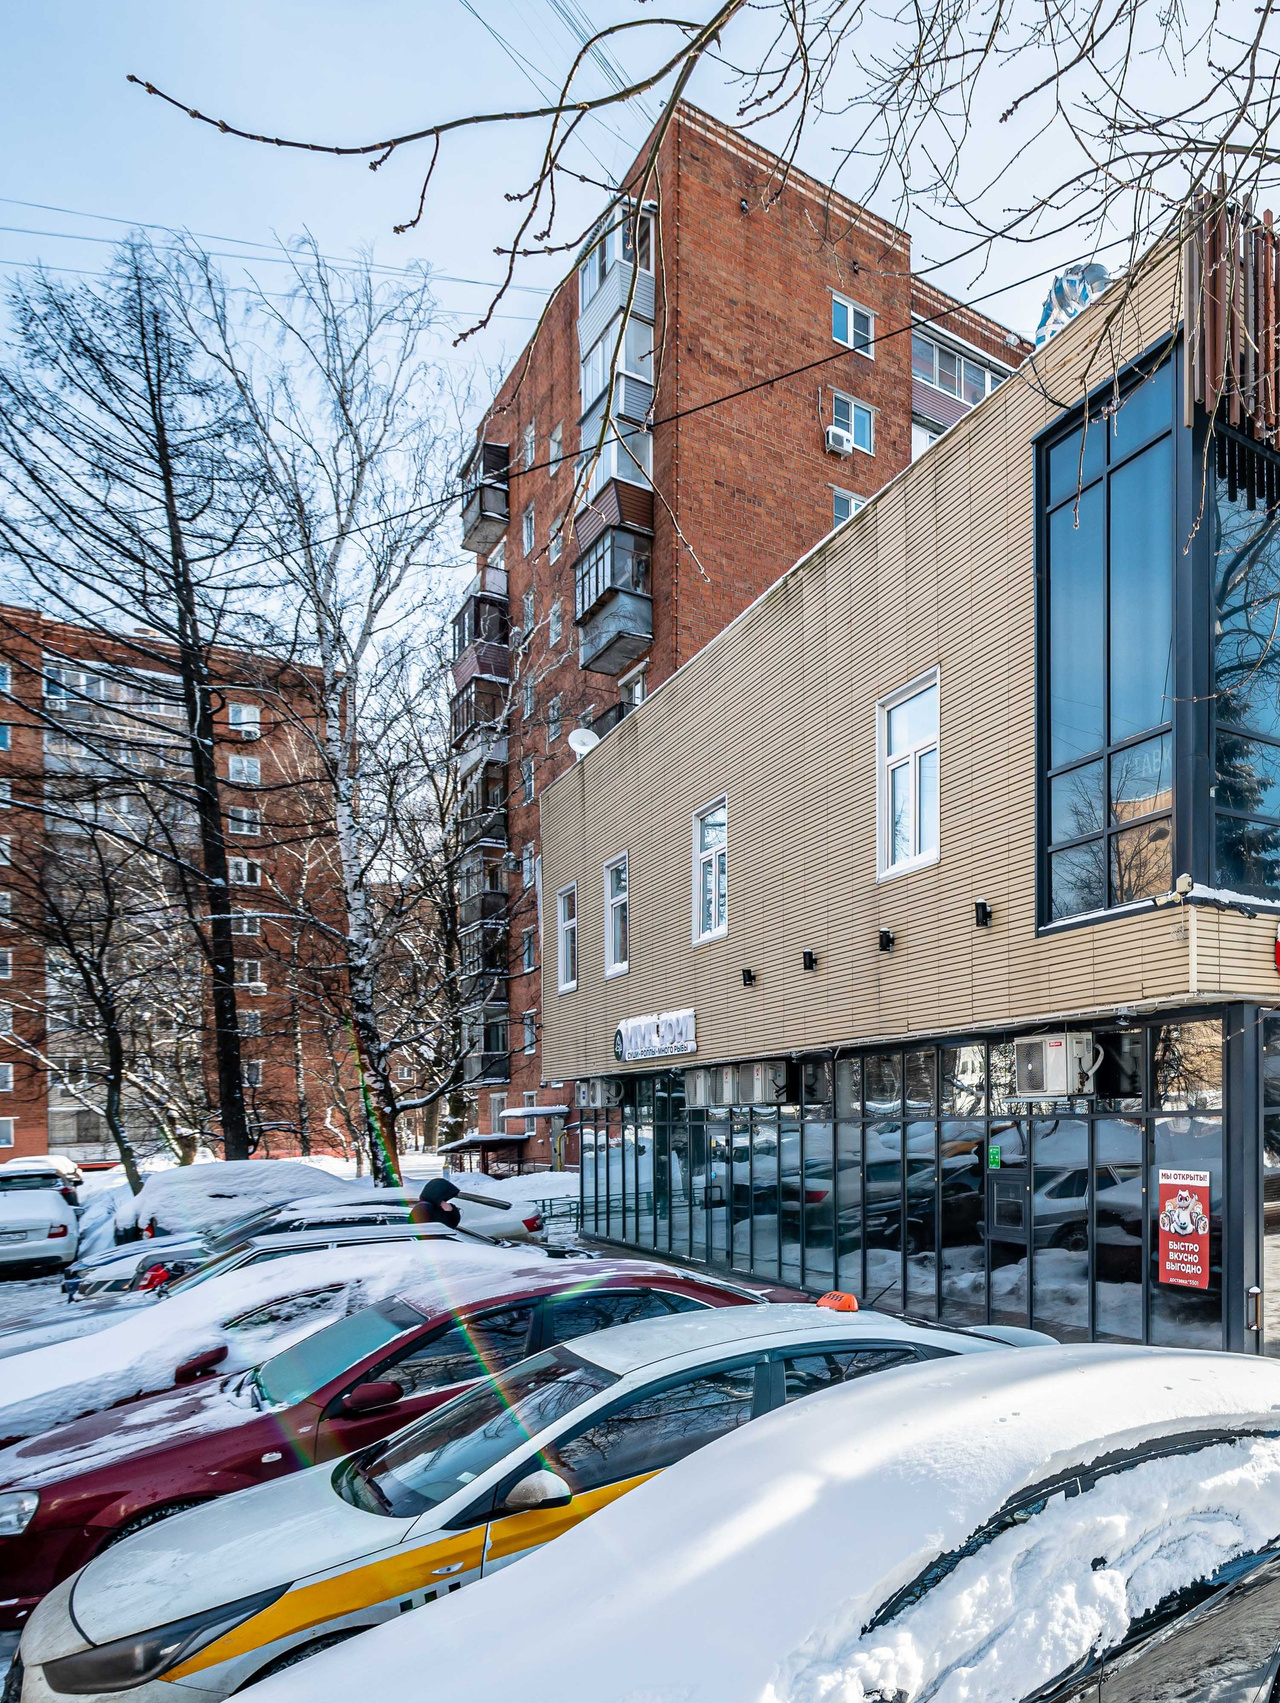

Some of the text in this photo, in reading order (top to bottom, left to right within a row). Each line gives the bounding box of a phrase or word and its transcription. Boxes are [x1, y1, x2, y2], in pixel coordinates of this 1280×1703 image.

[674, 1044, 689, 1053] РЫБЫ
[1161, 1172, 1172, 1180] МЫ
[1168, 1241, 1200, 1252] БЫСТРО
[1169, 1251, 1199, 1263] ВКУСНО
[1165, 1262, 1202, 1274] ВЫГОДНО
